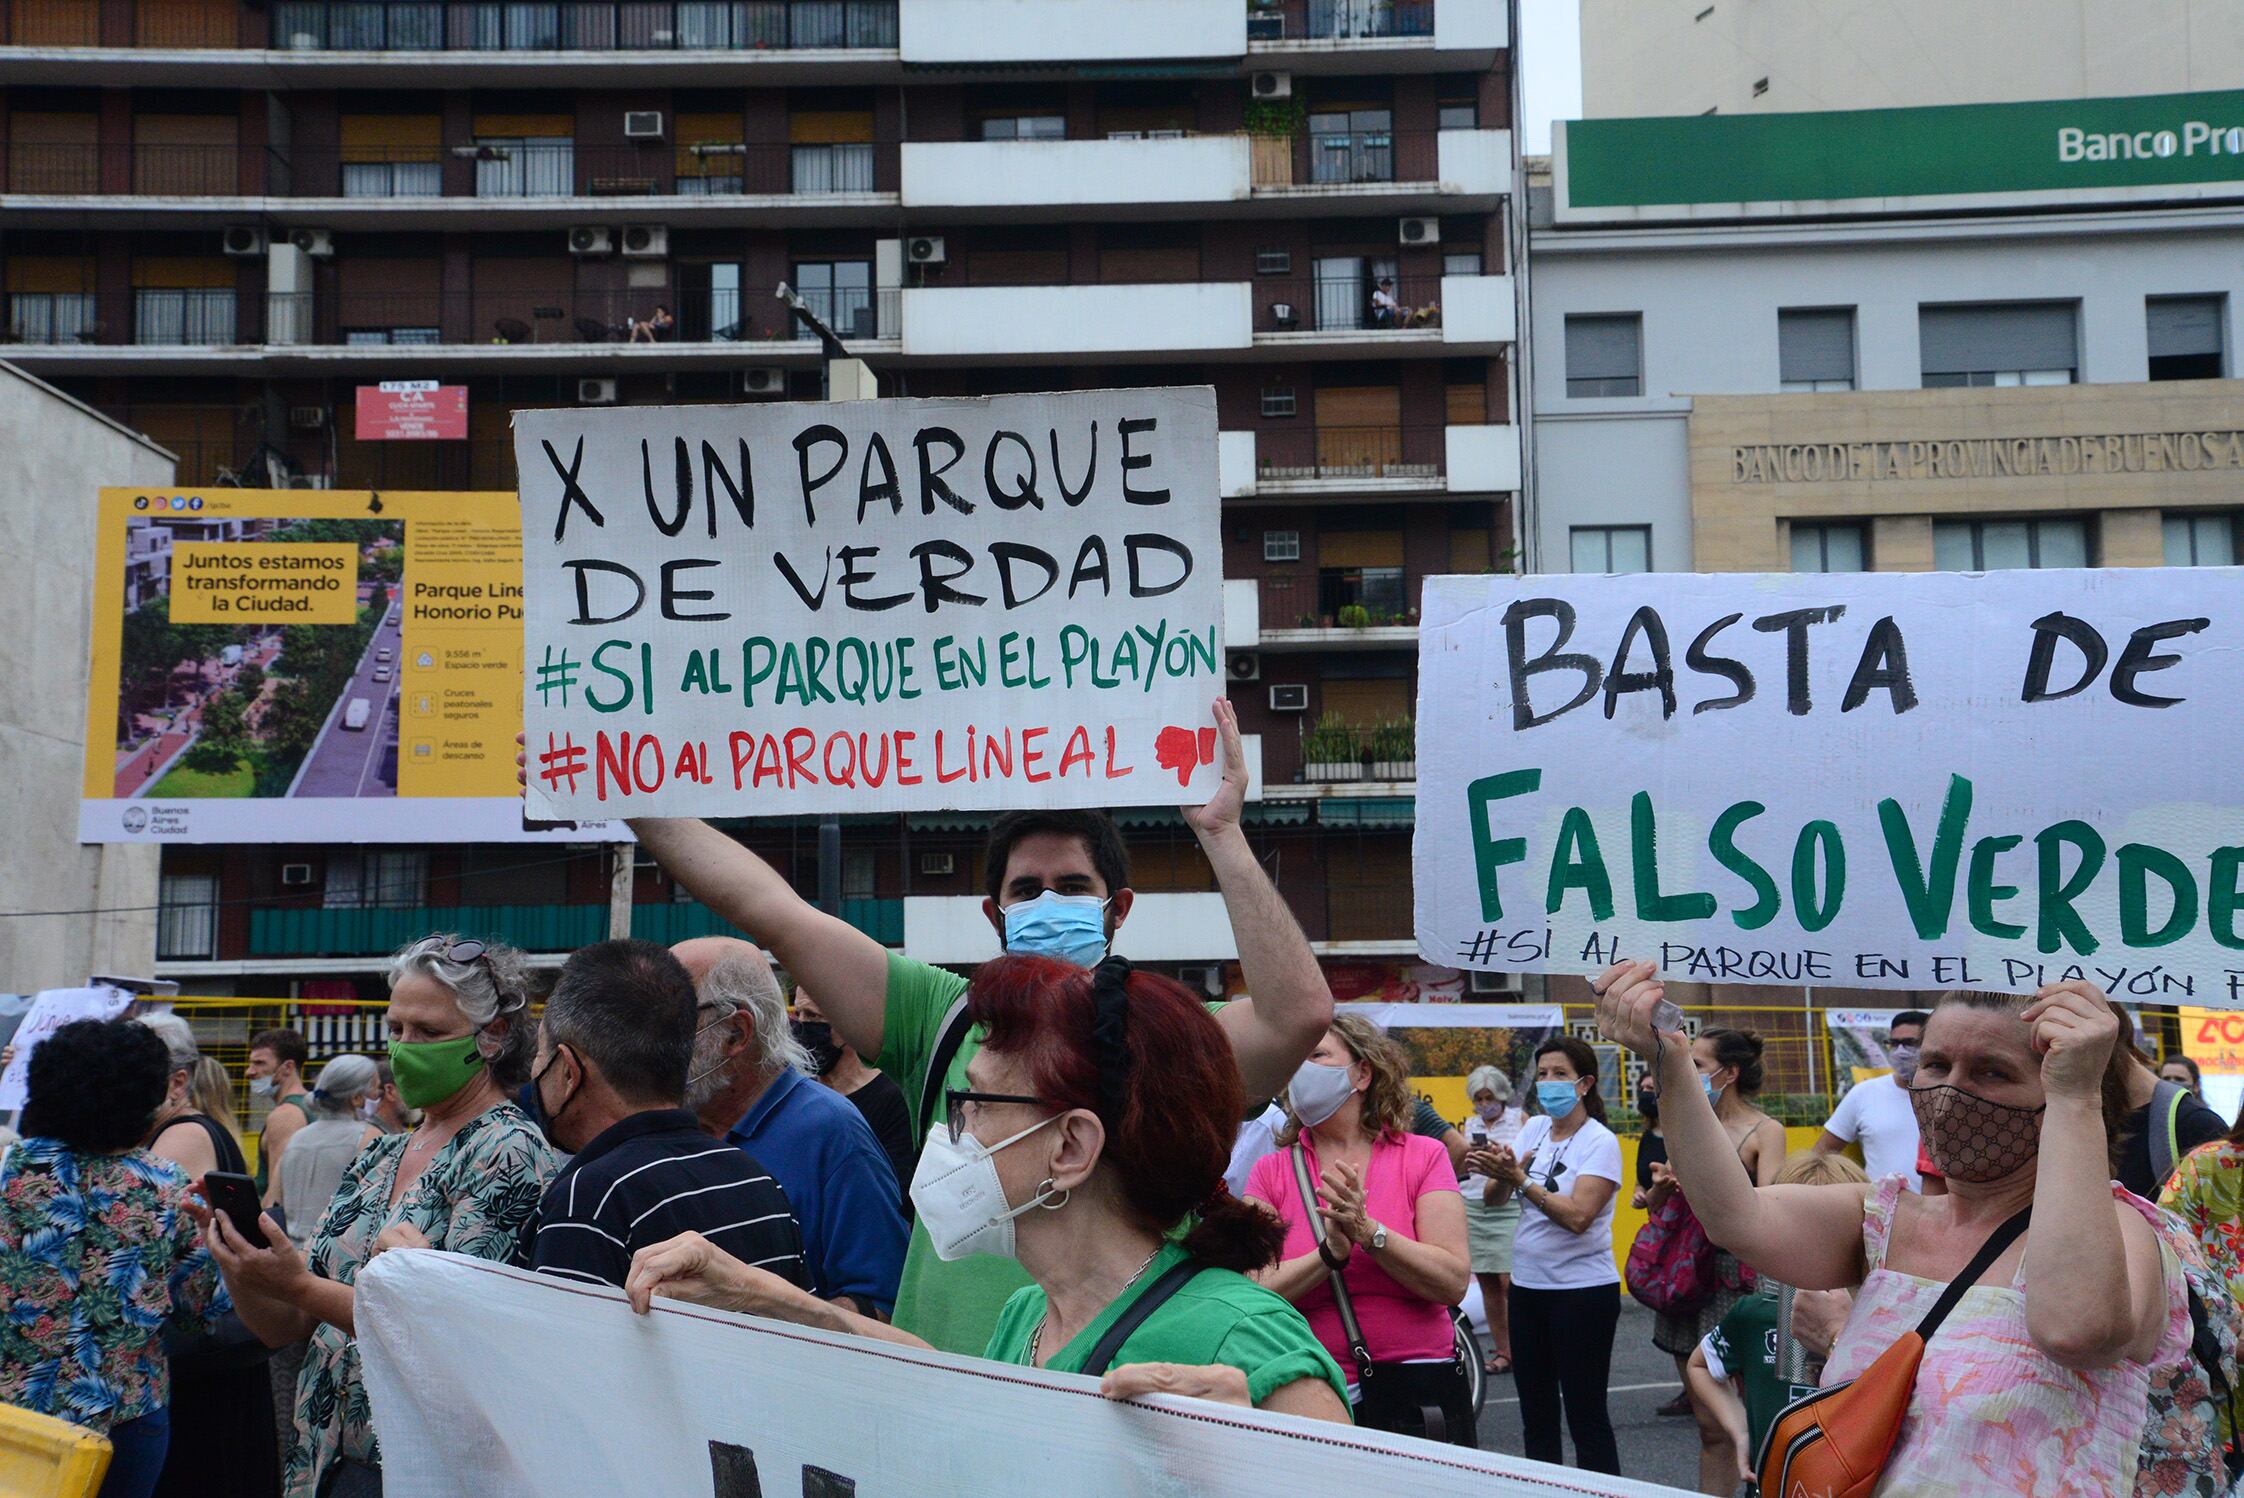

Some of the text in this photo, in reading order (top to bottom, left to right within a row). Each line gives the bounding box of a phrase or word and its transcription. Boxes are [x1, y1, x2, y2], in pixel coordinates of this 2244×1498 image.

[2058, 127, 2178, 162] Banco
[1732, 444, 1822, 484] BANCO
[1828, 442, 1863, 481] DE
[1870, 441, 1902, 480] LA
[1908, 438, 2056, 479] PROVINCIA
[2060, 436, 2097, 475] DE
[2104, 433, 2219, 473] BUENOS
[542, 417, 1170, 541] X UN PARQUE
[183, 553, 345, 572] Juntos estamos
[186, 574, 340, 592] transformando
[562, 533, 1193, 625] DE VERDAD
[414, 582, 523, 602] Parque Line
[212, 595, 314, 612] la Ciudad.
[414, 604, 491, 620] Honorio
[444, 661, 508, 670] Espacio verde
[536, 618, 1216, 715] #SI AL PARQUE EN EL PLAYÓN
[1502, 599, 2210, 731] BASTA DE
[444, 689, 475, 697] Cruces
[443, 700, 493, 709] peatonales
[443, 712, 479, 720] seguros
[470, 740, 483, 749] de
[442, 751, 485, 760] descanso
[540, 732, 664, 800] #NO
[675, 742, 713, 784] AL
[729, 728, 922, 790] PARQUE
[150, 825, 188, 834] Ciudad
[1467, 768, 1846, 932] FALSO
[1580, 932, 1628, 965] AL
[1661, 942, 1831, 979] PARQUE
[1855, 954, 1909, 978] EN
[1932, 957, 1982, 983] EL
